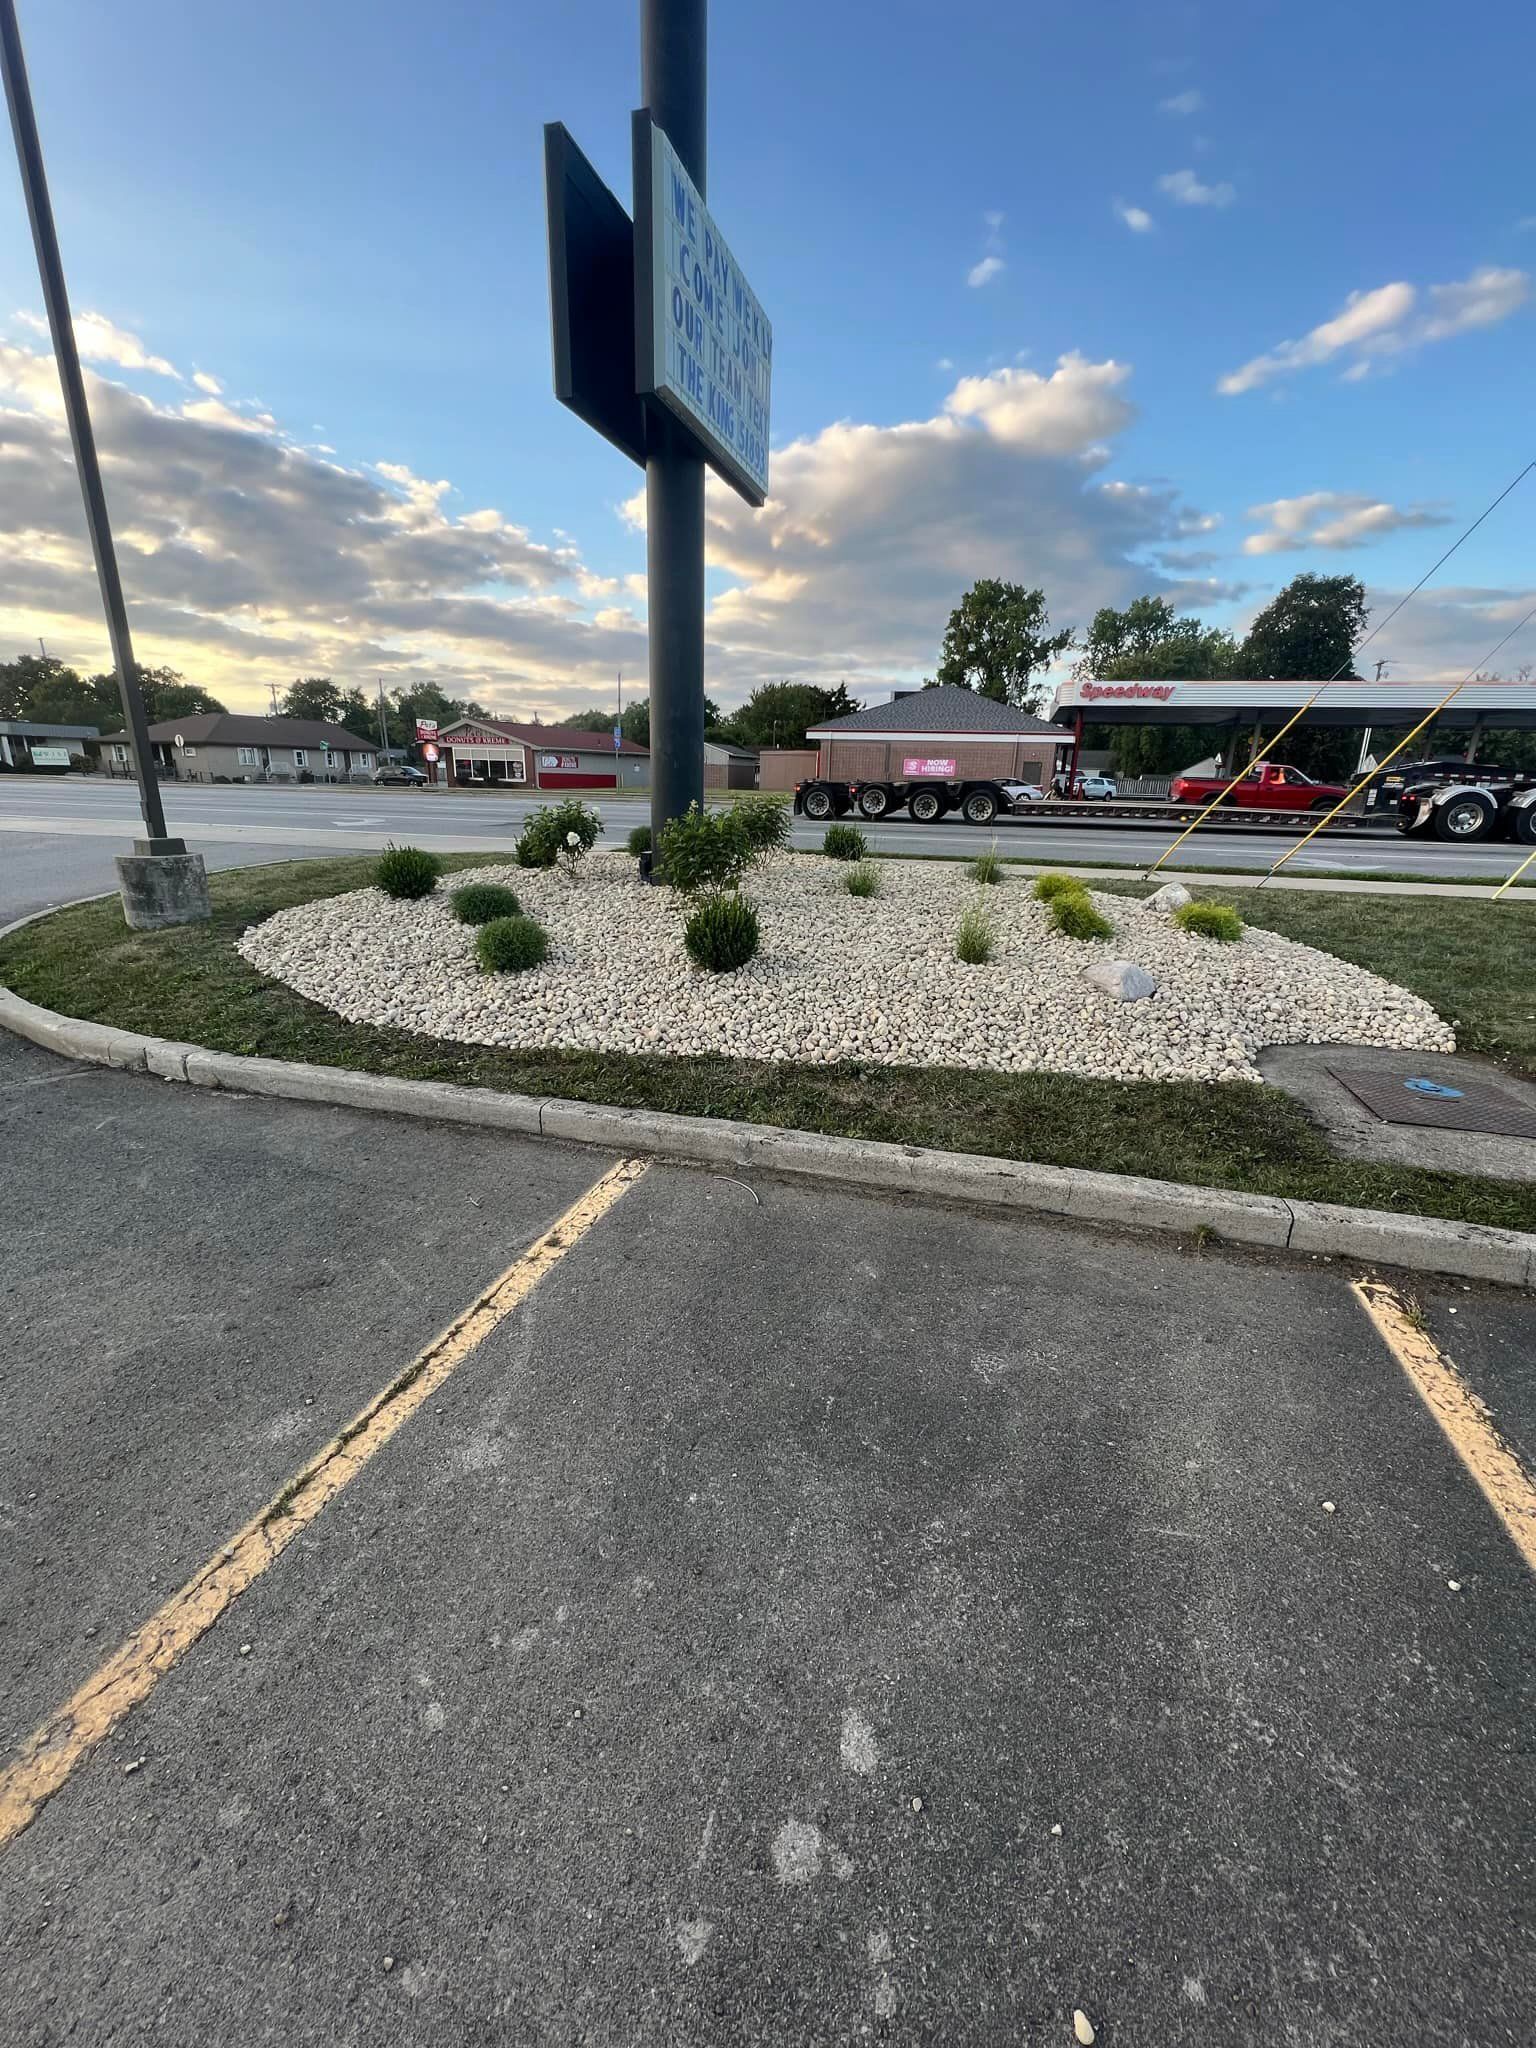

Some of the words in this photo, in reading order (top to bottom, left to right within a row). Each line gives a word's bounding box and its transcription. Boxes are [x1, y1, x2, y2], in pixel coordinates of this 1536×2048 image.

[672, 173, 696, 243] WE
[705, 229, 729, 297] PAY
[680, 244, 724, 337] COME
[672, 285, 703, 357] OUR
[711, 335, 742, 405] TEAM
[746, 386, 768, 441] TEXT
[677, 342, 705, 405] THE
[708, 380, 735, 442] KING
[1079, 682, 1177, 702] Speedway
[446, 736, 474, 744] DONUTS
[921, 765, 953, 773] HIRING!
